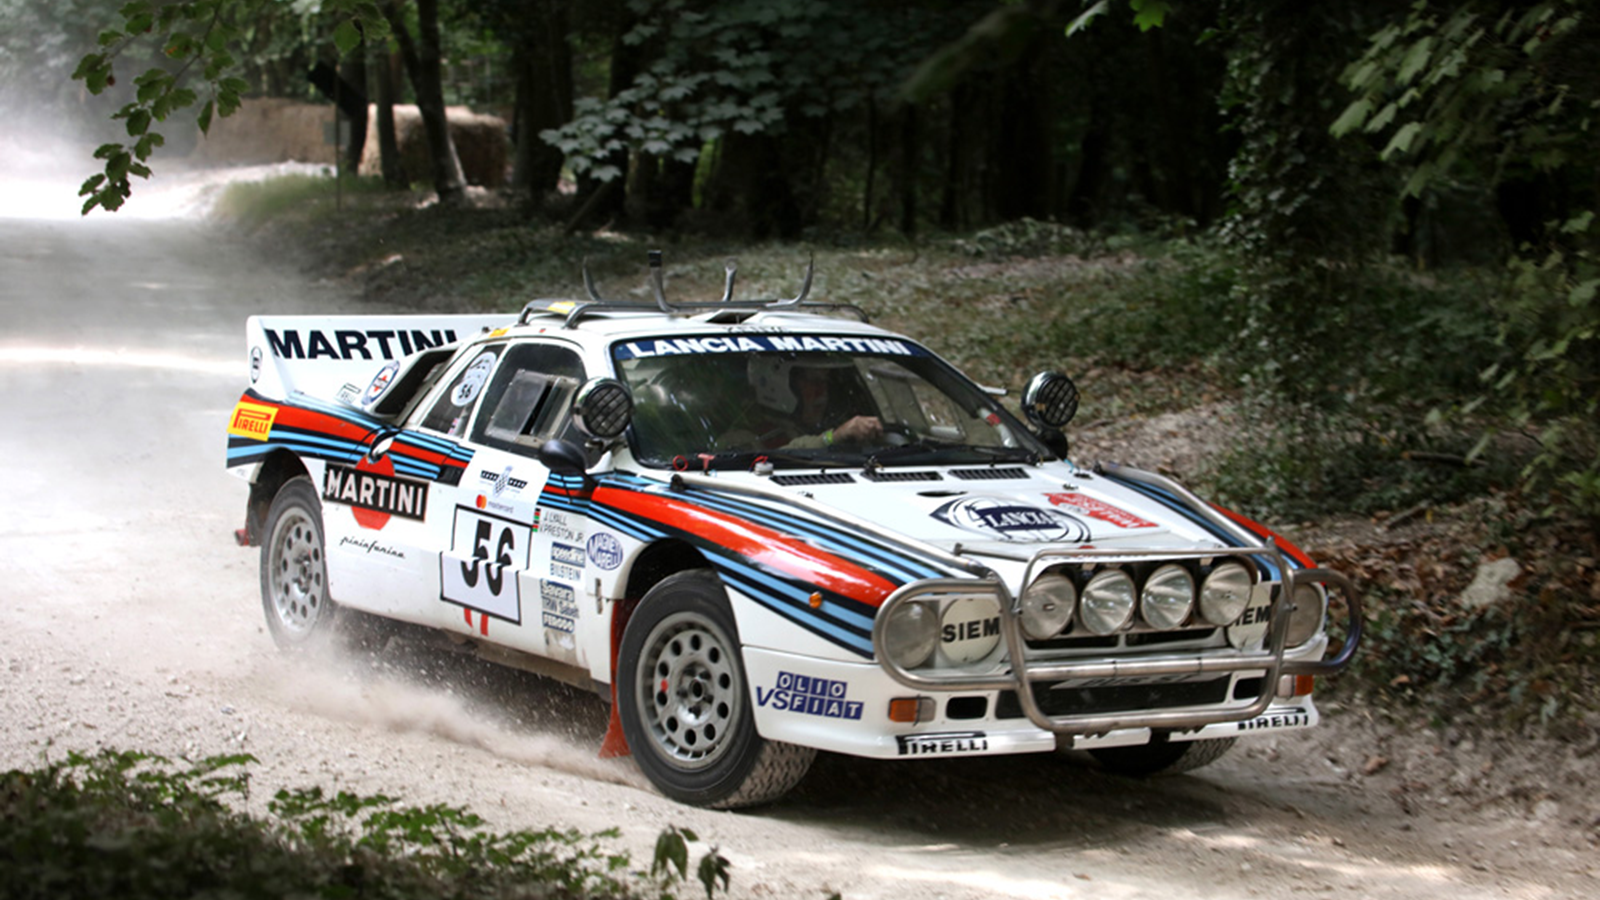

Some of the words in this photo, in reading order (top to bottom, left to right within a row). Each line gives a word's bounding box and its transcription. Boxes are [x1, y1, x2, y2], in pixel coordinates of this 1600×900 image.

[627, 337, 761, 357] LANCIA
[767, 337, 912, 355] MARTINI
[458, 384, 473, 399] 56
[232, 408, 272, 435] PIRELLI
[325, 467, 423, 516] MARTINI
[987, 511, 1055, 528] LANCIA
[460, 518, 515, 597] 56
[942, 616, 1000, 643] SIEM
[1235, 605, 1271, 627] EM
[778, 671, 846, 698] OLIO
[756, 686, 790, 710] VS
[791, 696, 861, 719] FIAT
[895, 731, 988, 756] PIRELLI
